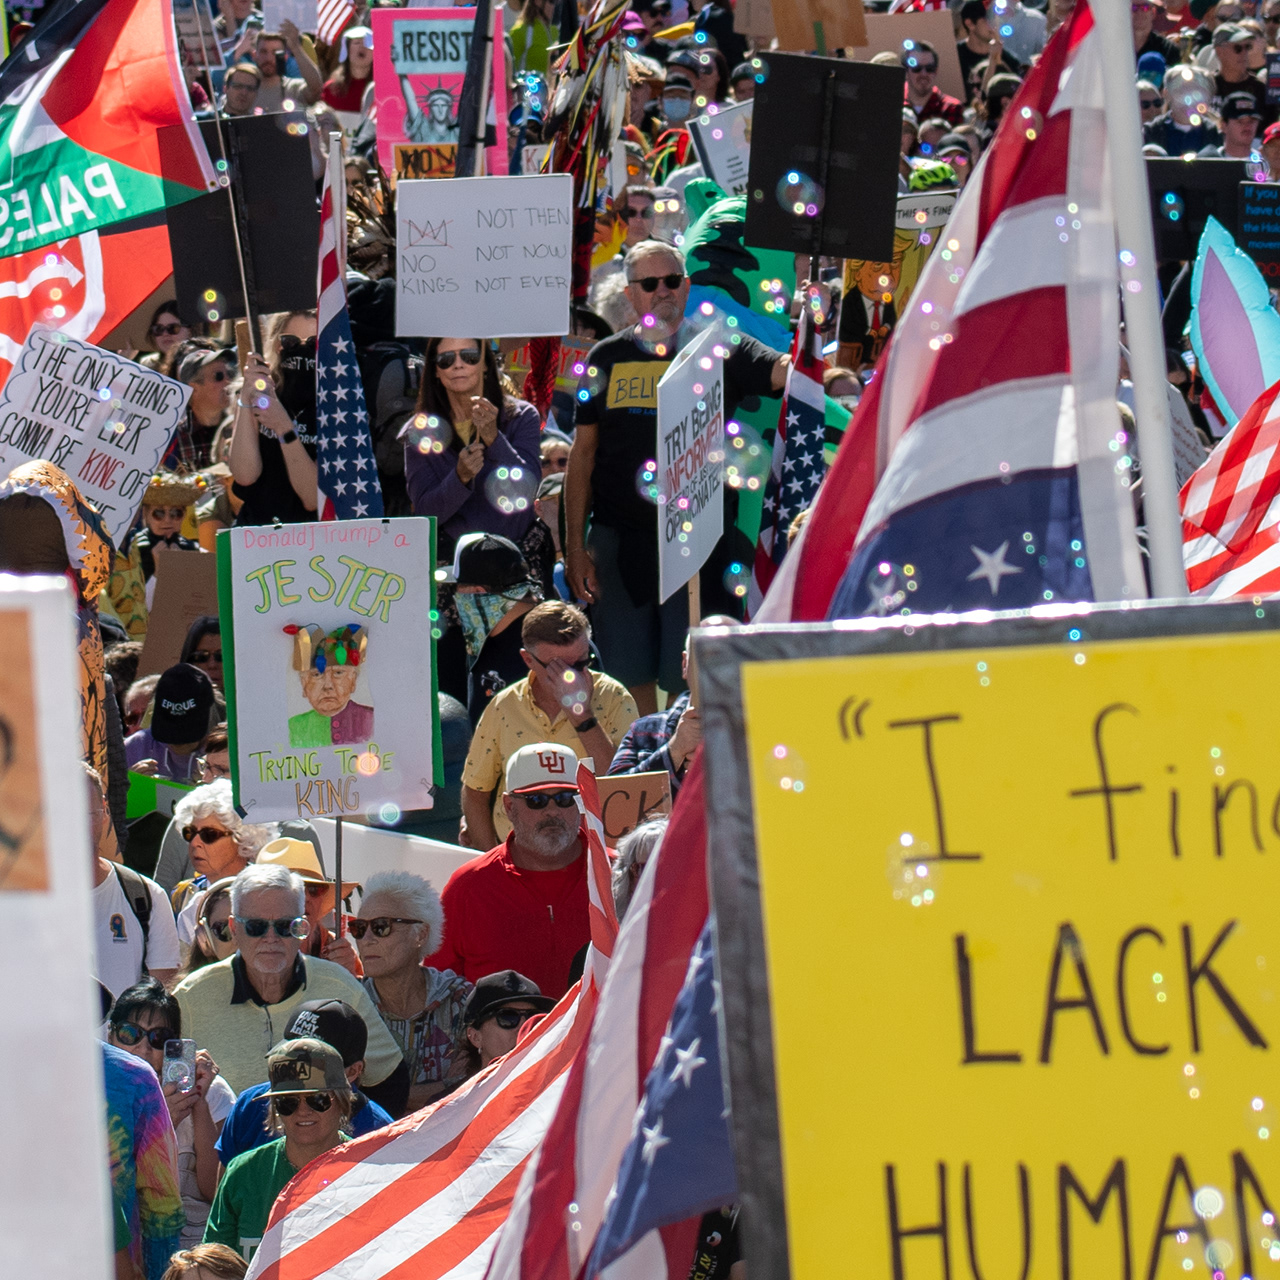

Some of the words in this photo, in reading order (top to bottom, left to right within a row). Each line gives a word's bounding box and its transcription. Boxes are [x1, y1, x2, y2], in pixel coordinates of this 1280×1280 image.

[403, 30, 473, 62] RESIST
[1245, 186, 1255, 198] If
[1257, 189, 1278, 202] you
[1245, 203, 1269, 216] have
[476, 208, 517, 229] NOT
[524, 207, 570, 228] THEN
[896, 207, 918, 219] THIS
[933, 205, 953, 217] FINE
[1244, 221, 1260, 232] the
[401, 254, 436, 274] NO
[476, 245, 515, 261] NOT
[523, 243, 567, 260] NOW
[402, 277, 460, 295] KINGS
[475, 277, 515, 293] NOT
[521, 275, 569, 290] EVER
[32, 335, 77, 374] THE
[72, 355, 127, 391] ONLY
[126, 375, 177, 416] THING
[33, 380, 99, 430] YOU'RE
[665, 423, 689, 466] TRY
[688, 380, 721, 438] BEING
[51, 434, 83, 471] BE
[79, 448, 125, 491] KING
[121, 471, 148, 501] OF
[244, 523, 305, 551] Donald
[318, 521, 382, 547] Trump
[393, 534, 411, 549] a
[246, 554, 407, 623] JESTER
[161, 698, 197, 711] EPIQUE
[249, 749, 322, 783] TRYING
[295, 778, 361, 820] KING
[955, 920, 1267, 1066] LACK
